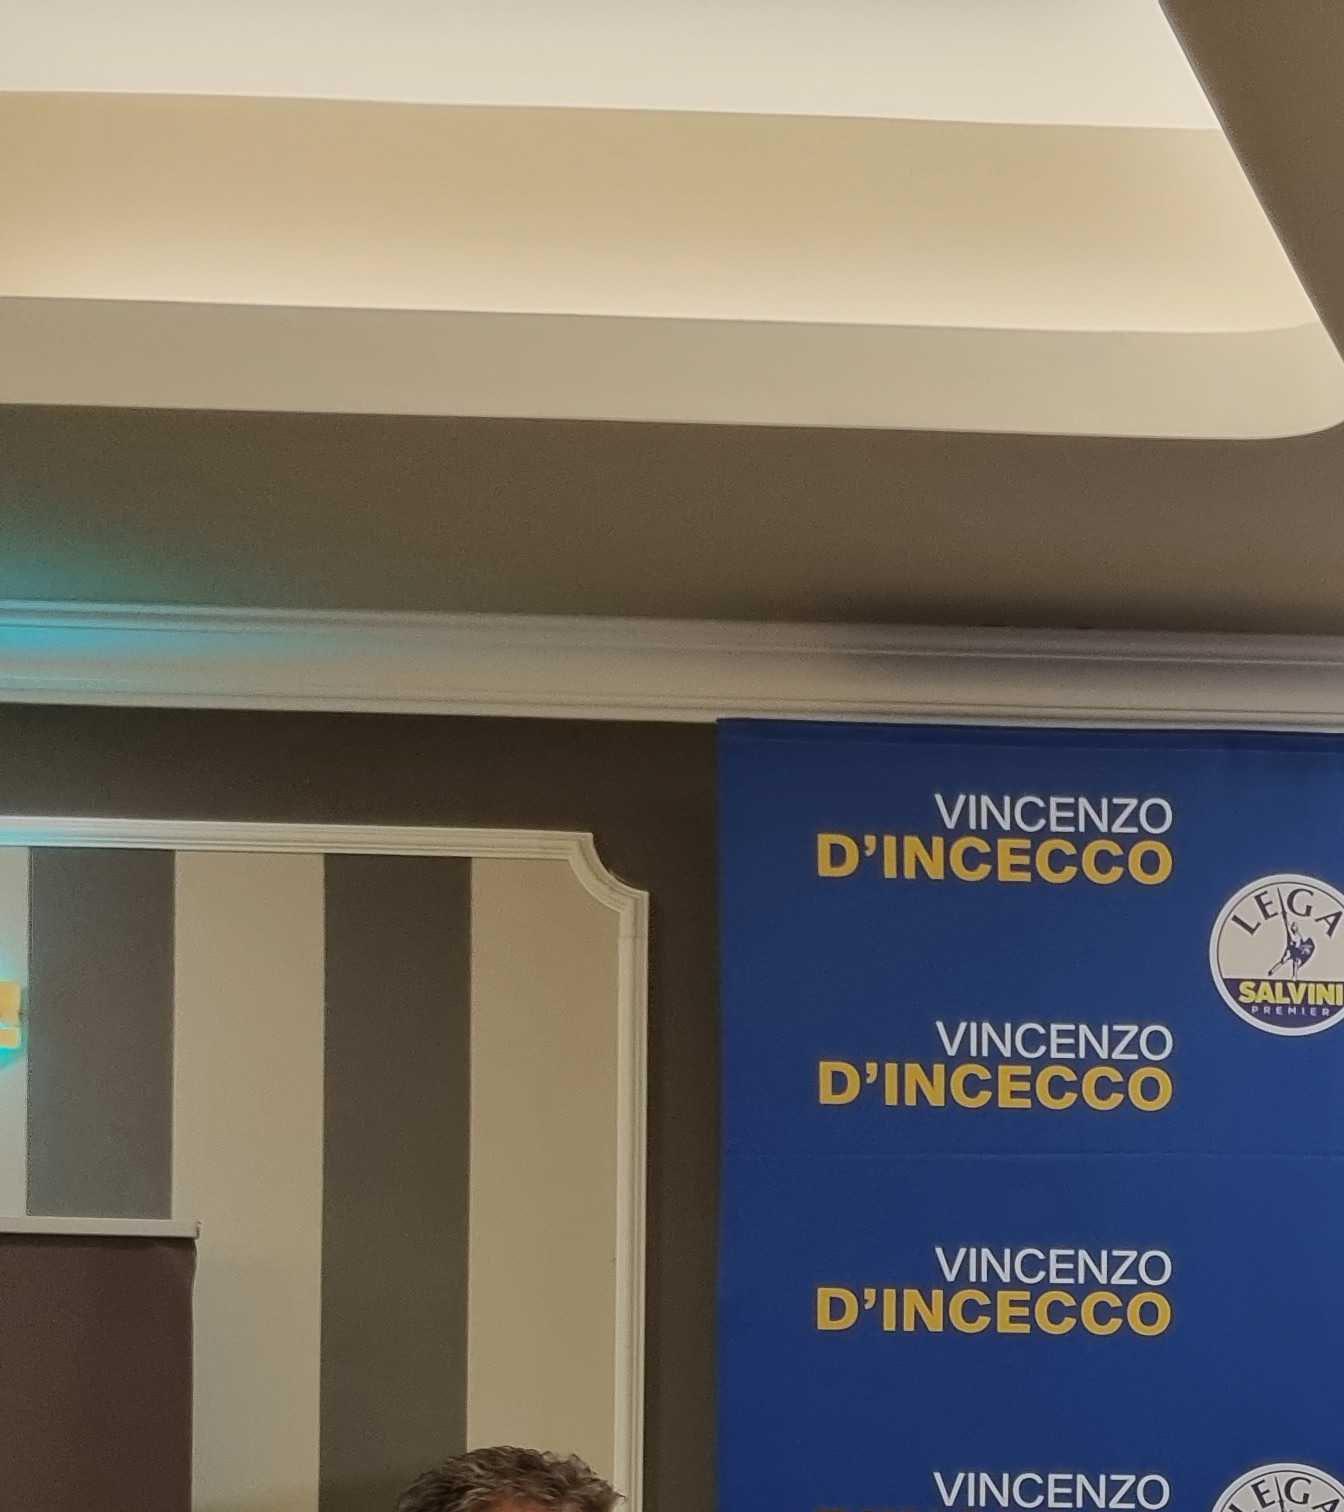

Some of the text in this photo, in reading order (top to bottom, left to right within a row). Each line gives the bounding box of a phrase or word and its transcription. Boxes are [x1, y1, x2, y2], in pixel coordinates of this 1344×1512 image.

[935, 793, 1173, 834] VINCENZO
[817, 833, 1173, 885] D'INCECCO
[1231, 887, 1344, 937] LEGA
[1238, 981, 1344, 1006] SALVINI
[1251, 1006, 1330, 1017] PREMIER
[935, 1021, 1174, 1060] VINCENZO
[818, 1061, 1173, 1111] D'INCECCO
[935, 1248, 1172, 1286] VINCENZO
[816, 1287, 1172, 1335] D'INCECCO
[933, 1472, 1169, 1510] VINCENZO
